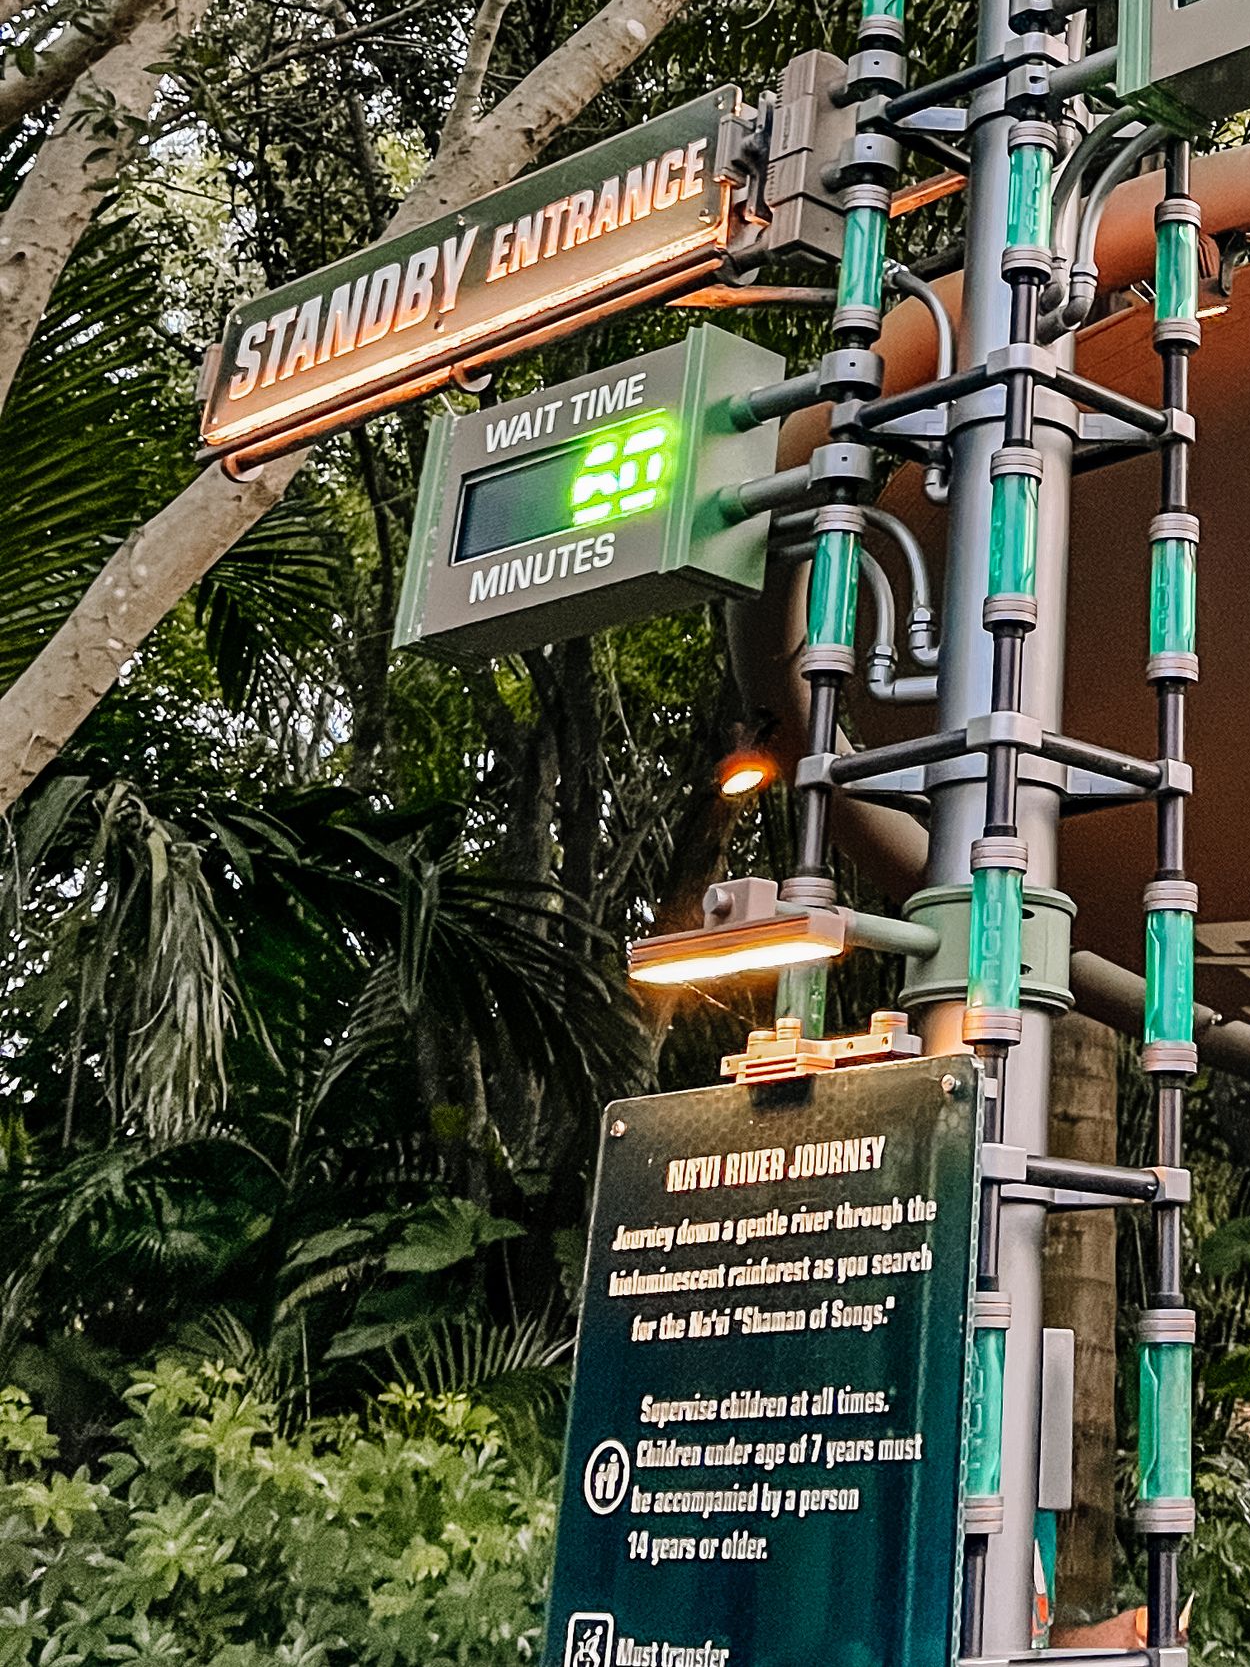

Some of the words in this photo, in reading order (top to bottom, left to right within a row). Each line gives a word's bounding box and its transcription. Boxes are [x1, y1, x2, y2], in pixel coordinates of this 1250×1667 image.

[228, 224, 479, 401] STANDBY
[485, 138, 708, 284] ENTRANCE
[485, 400, 563, 453] WAIT
[569, 372, 647, 426] TIME
[468, 532, 616, 604] MINUTES
[724, 1148, 785, 1186] RIVER
[788, 1135, 886, 1179] JOURNEY
[611, 1224, 675, 1252] Journey
[676, 1218, 720, 1245] down
[721, 1220, 734, 1241] a
[736, 1209, 788, 1245] gentle
[790, 1206, 834, 1234] river
[835, 1197, 903, 1231] through
[906, 1195, 937, 1223] the
[608, 1266, 725, 1297] bioluminescent
[727, 1256, 810, 1287] rainforest
[812, 1259, 833, 1280] as
[836, 1254, 868, 1283] you
[871, 1243, 932, 1275] search
[631, 1314, 657, 1342] for
[659, 1312, 686, 1339] the
[808, 1300, 829, 1330] of
[640, 1393, 718, 1428] Supervise
[720, 1389, 787, 1420] children
[790, 1391, 809, 1416] at
[811, 1387, 834, 1415] all
[837, 1385, 890, 1414] times.
[636, 1439, 702, 1468] Children
[704, 1437, 752, 1465] under
[754, 1441, 786, 1470] age
[789, 1433, 808, 1463] of
[810, 1433, 823, 1463] 7
[826, 1437, 874, 1469] years
[877, 1433, 923, 1461] must
[630, 1486, 652, 1514] be
[653, 1483, 758, 1519] accompanied
[761, 1483, 783, 1518] by
[785, 1490, 796, 1513] a
[798, 1488, 860, 1518] person
[627, 1530, 649, 1560] 14
[650, 1537, 696, 1566] years
[699, 1537, 719, 1560] or
[720, 1530, 769, 1560] older.
[614, 1638, 660, 1667] Must
[661, 1640, 730, 1667] transfer
